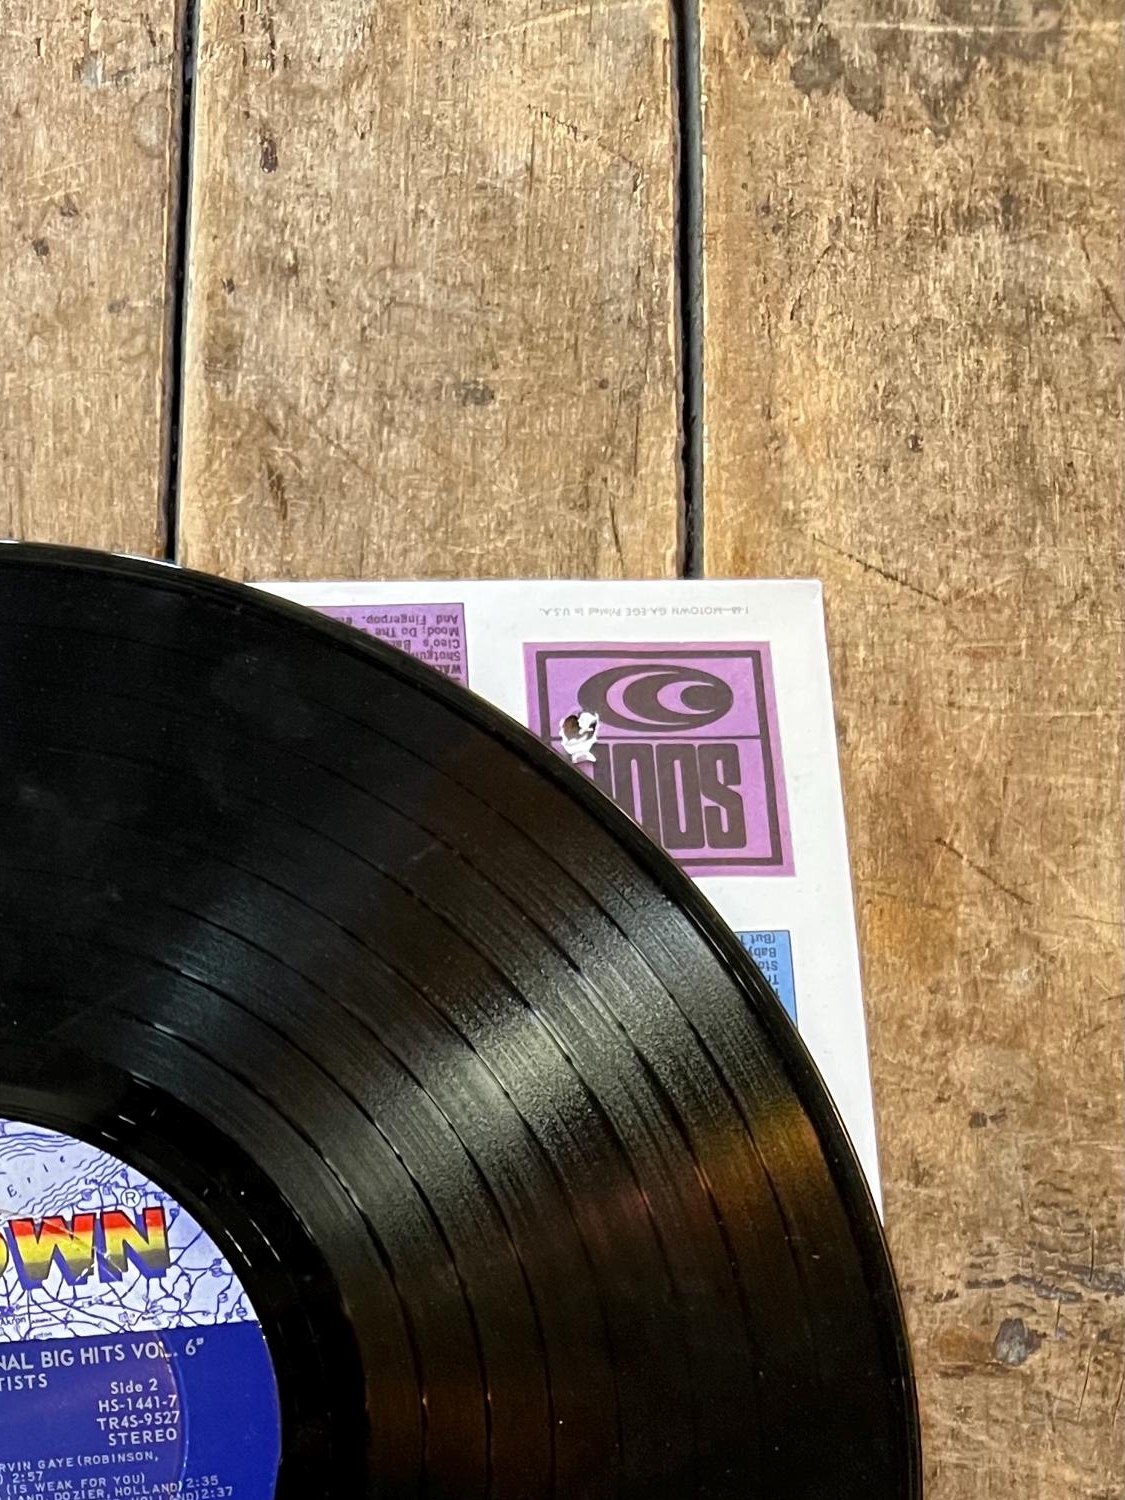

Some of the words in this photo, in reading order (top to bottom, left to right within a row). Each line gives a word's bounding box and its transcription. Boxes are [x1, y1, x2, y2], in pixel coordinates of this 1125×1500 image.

[436, 615, 458, 625] And
[750, 934, 775, 944] (But
[41, 1349, 74, 1369] BIG
[81, 1344, 125, 1365] HITS
[131, 1339, 177, 1361] VOL.
[110, 1379, 143, 1395] Side
[149, 1378, 158, 1391] 2
[98, 1393, 177, 1414] HS-1441-7
[96, 1410, 180, 1431] TR4S-9527
[108, 1428, 177, 1446] STEREO
[6, 1483, 28, 1496] (IS
[35, 1480, 73, 1492] WEAK
[81, 1477, 107, 1489] FOR
[113, 1473, 146, 1487] YOU)
[12, 1471, 44, 1483] 2:57
